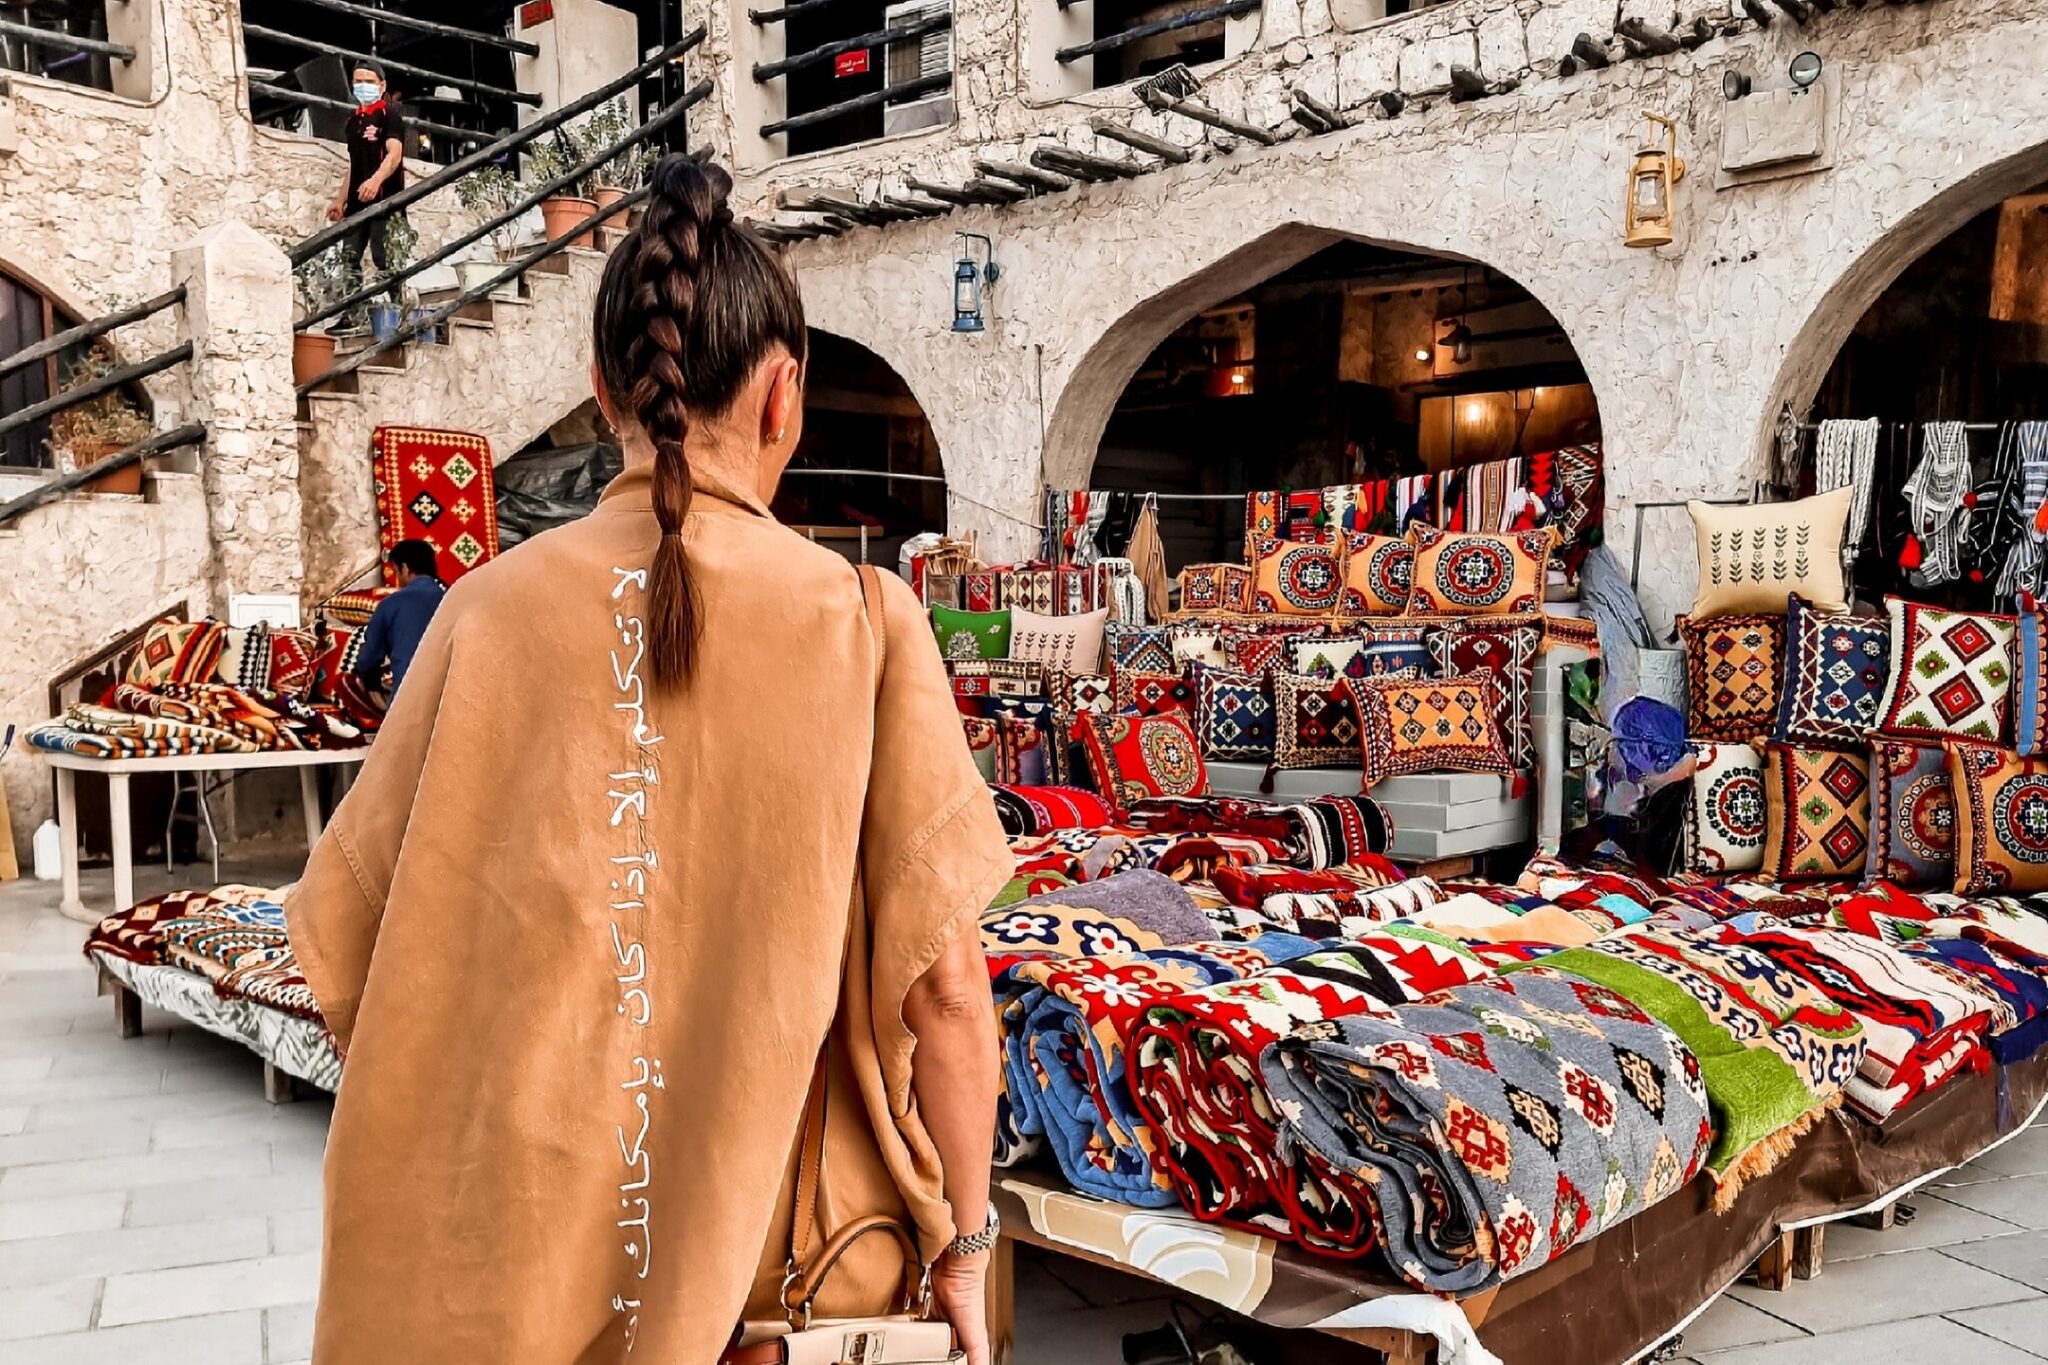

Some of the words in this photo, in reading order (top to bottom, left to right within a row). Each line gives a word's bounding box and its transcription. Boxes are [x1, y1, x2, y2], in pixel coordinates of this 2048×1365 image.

[611, 566, 648, 599] لا
[609, 613, 666, 746] تتكلم
[606, 765, 659, 828] إلا
[608, 849, 659, 912] إذا
[609, 922, 650, 1027] كان
[615, 1057, 666, 1280] بإمكانك
